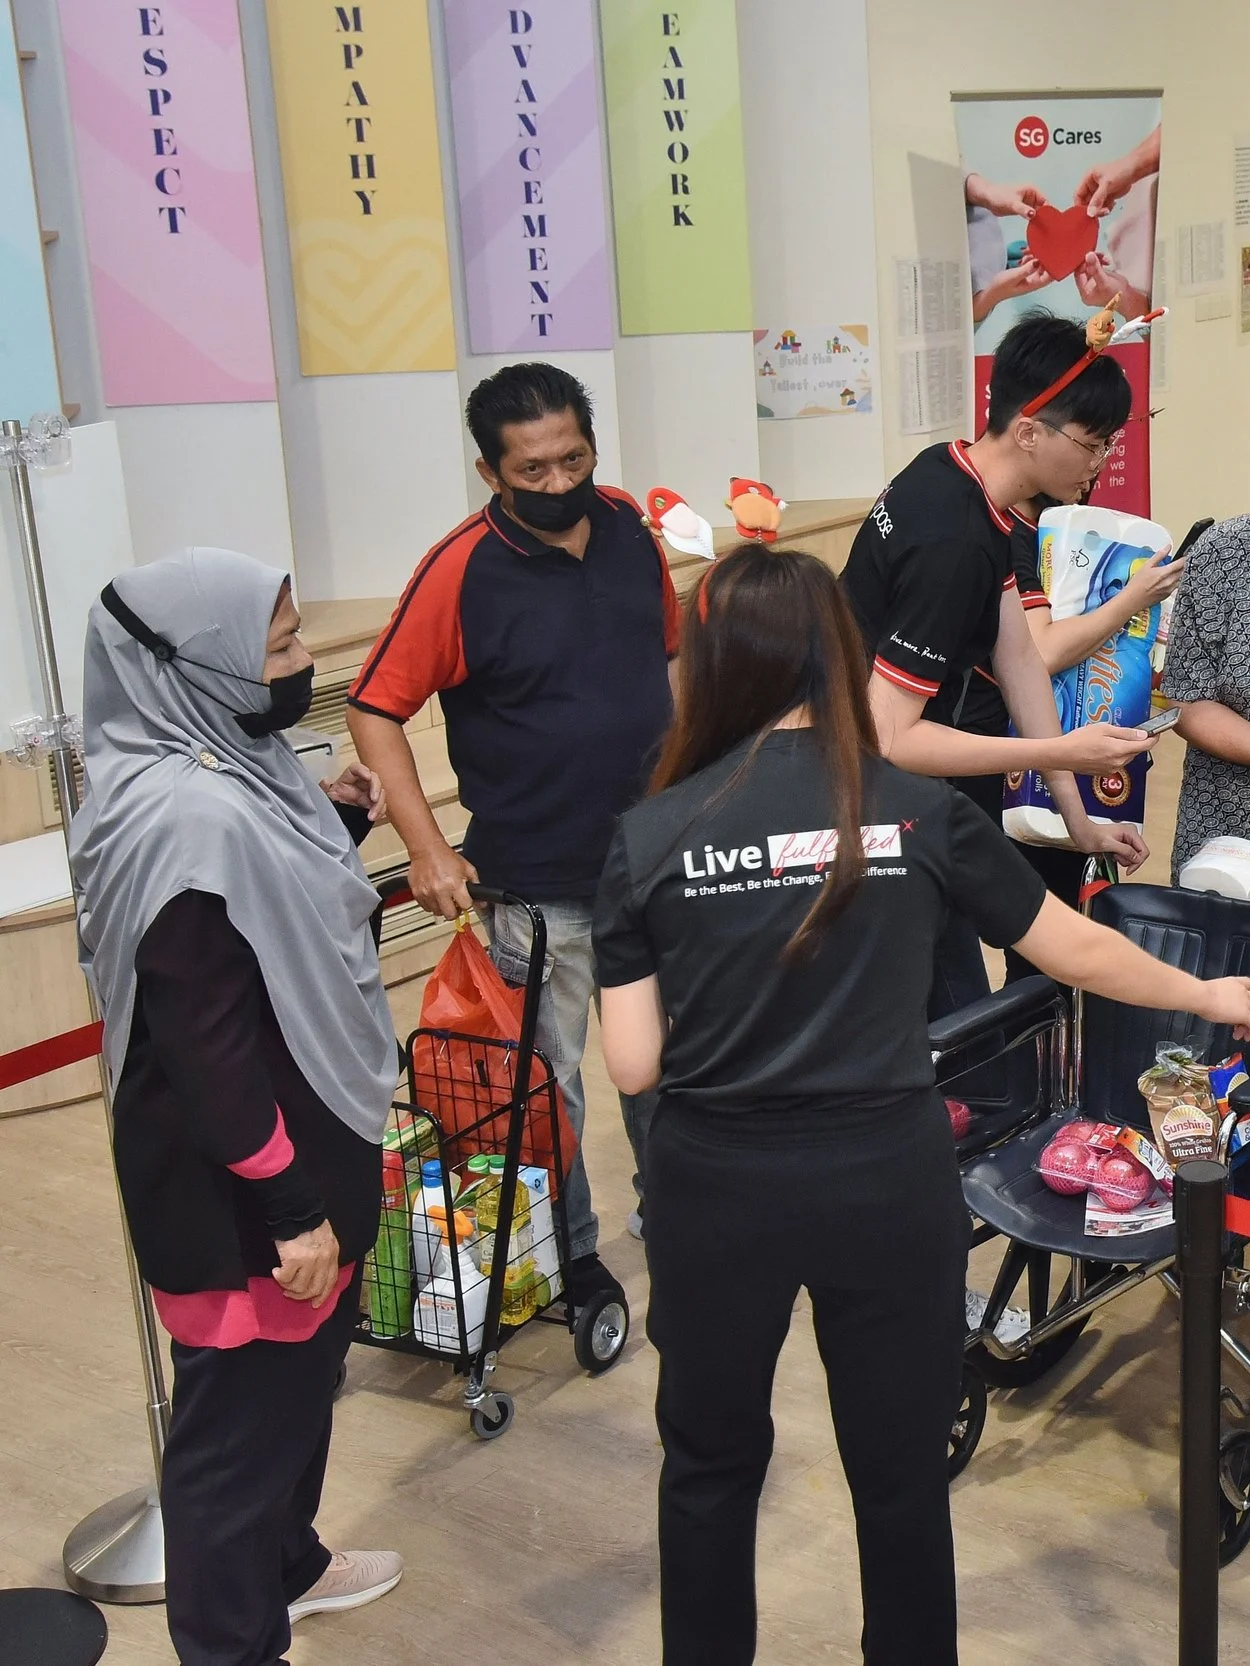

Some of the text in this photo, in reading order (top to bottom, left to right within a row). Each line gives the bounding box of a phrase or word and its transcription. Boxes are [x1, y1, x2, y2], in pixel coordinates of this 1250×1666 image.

[1019, 128, 1102, 146] SG Cares
[1110, 461, 1125, 470] we
[1110, 476, 1125, 486] the
[1107, 778, 1123, 793] 3
[683, 845, 763, 880] Live
[685, 888, 698, 898] Be
[699, 885, 717, 896] the
[719, 882, 745, 894] Best,
[747, 880, 762, 890] Be
[763, 878, 780, 888] the
[782, 873, 823, 886] Change,
[1163, 1120, 1211, 1136] Sunshine
[1172, 1145, 1213, 1157] Ultra Fine
